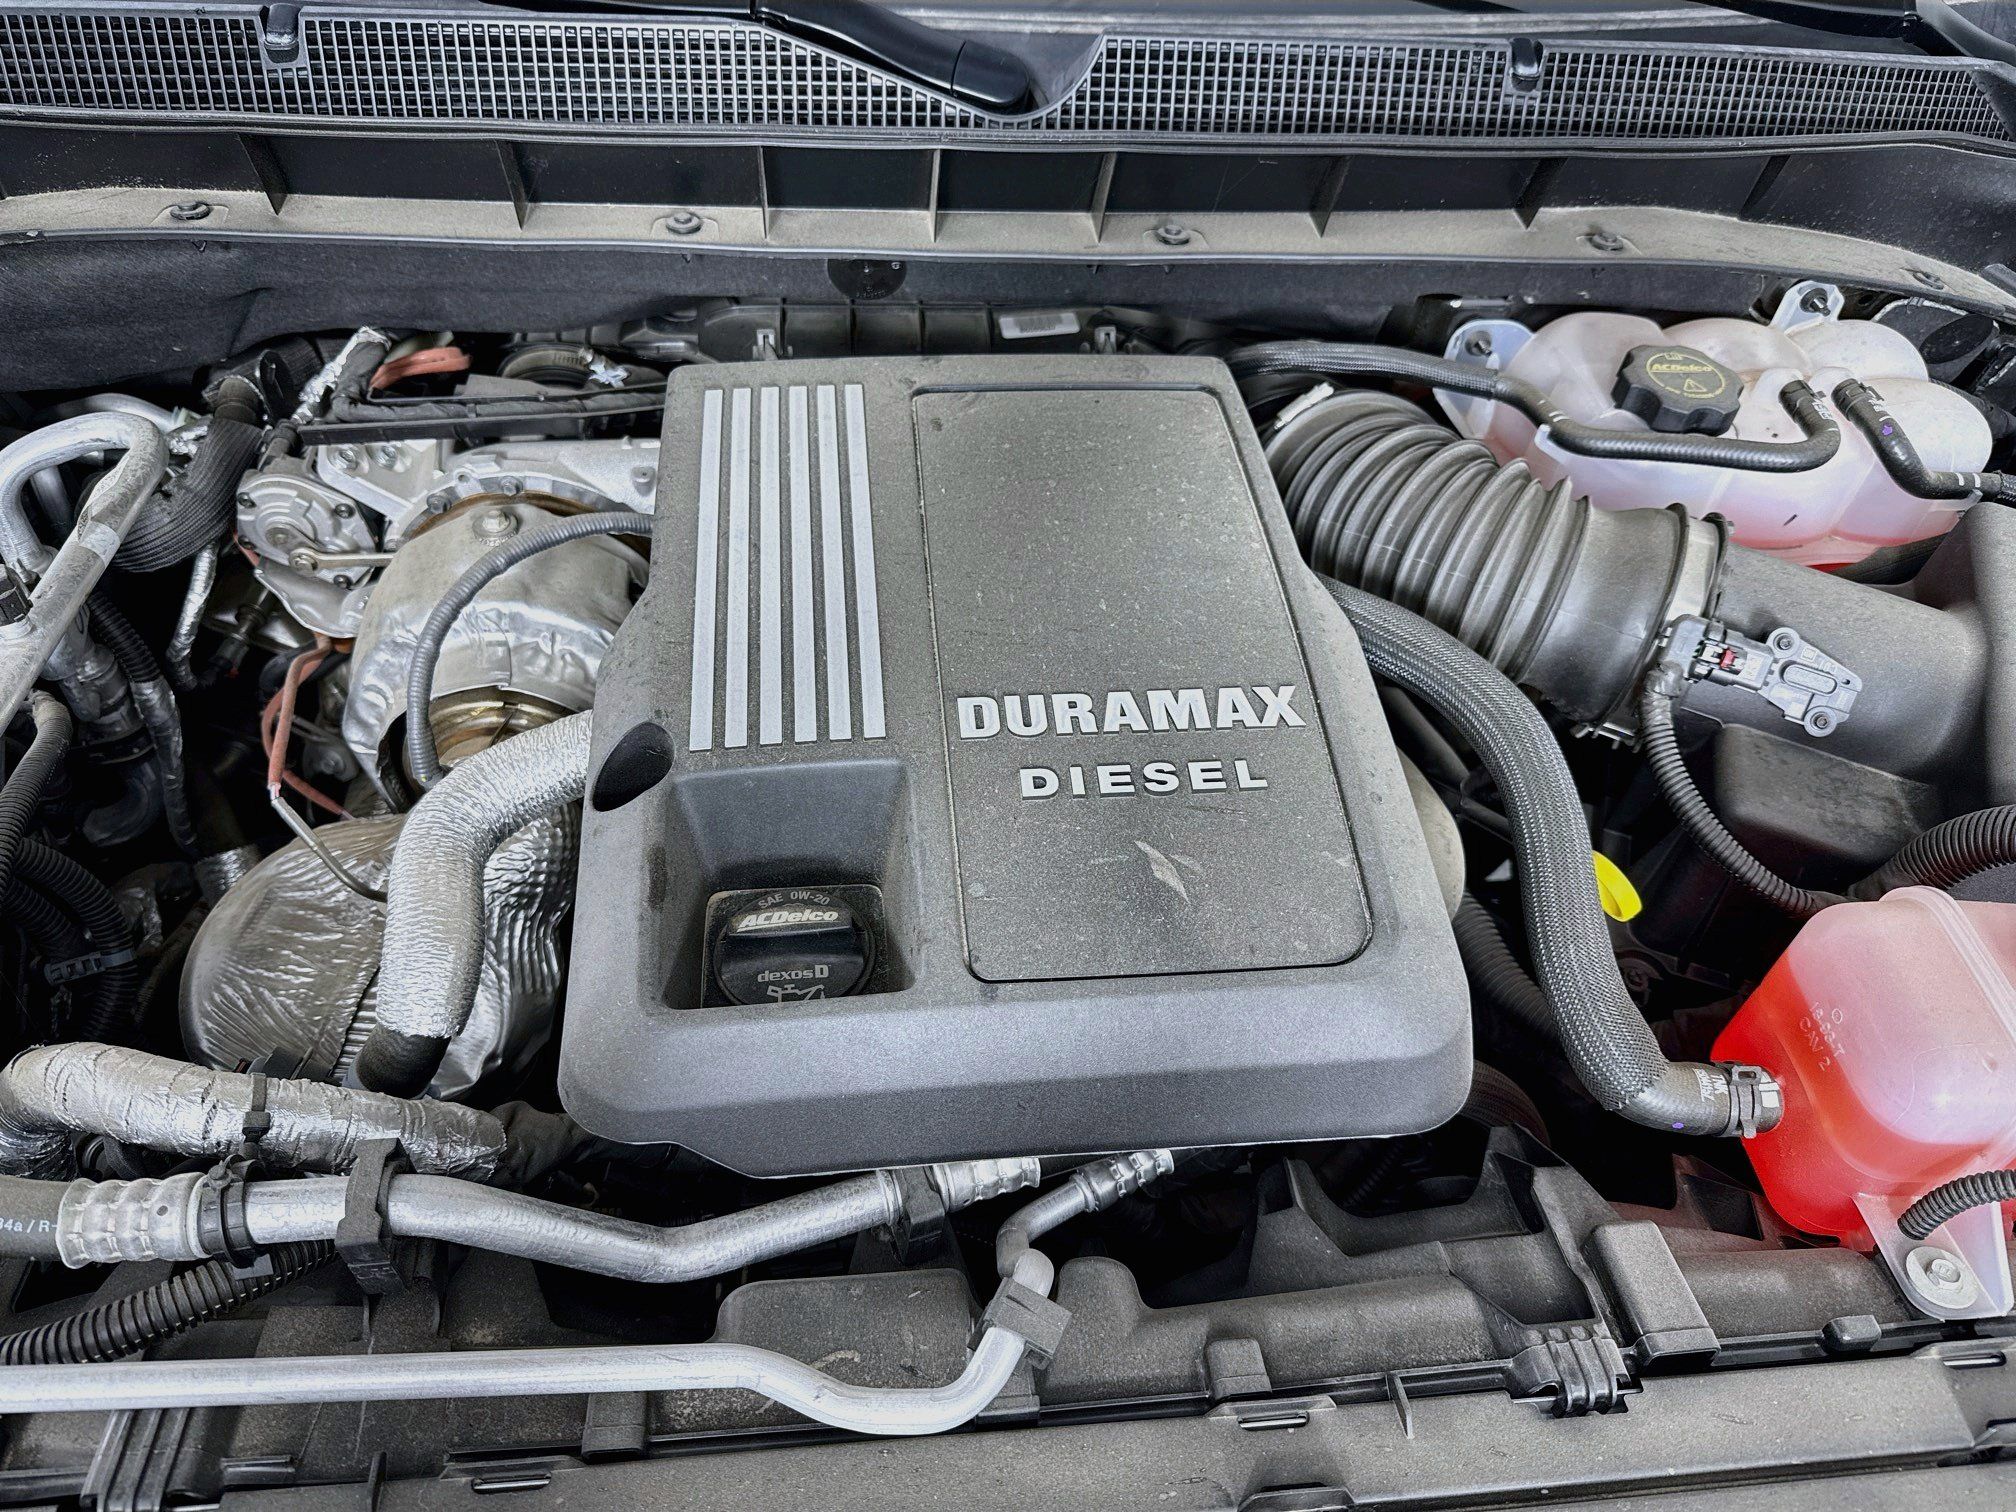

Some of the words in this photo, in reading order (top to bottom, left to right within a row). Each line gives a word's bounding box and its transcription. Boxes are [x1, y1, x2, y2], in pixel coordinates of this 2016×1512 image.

[956, 684, 1307, 740] DURAMAX
[1019, 758, 1269, 800] DIESEL
[757, 892, 785, 910] SAE
[789, 890, 831, 907] 0W-20
[737, 908, 839, 931] ACDelco
